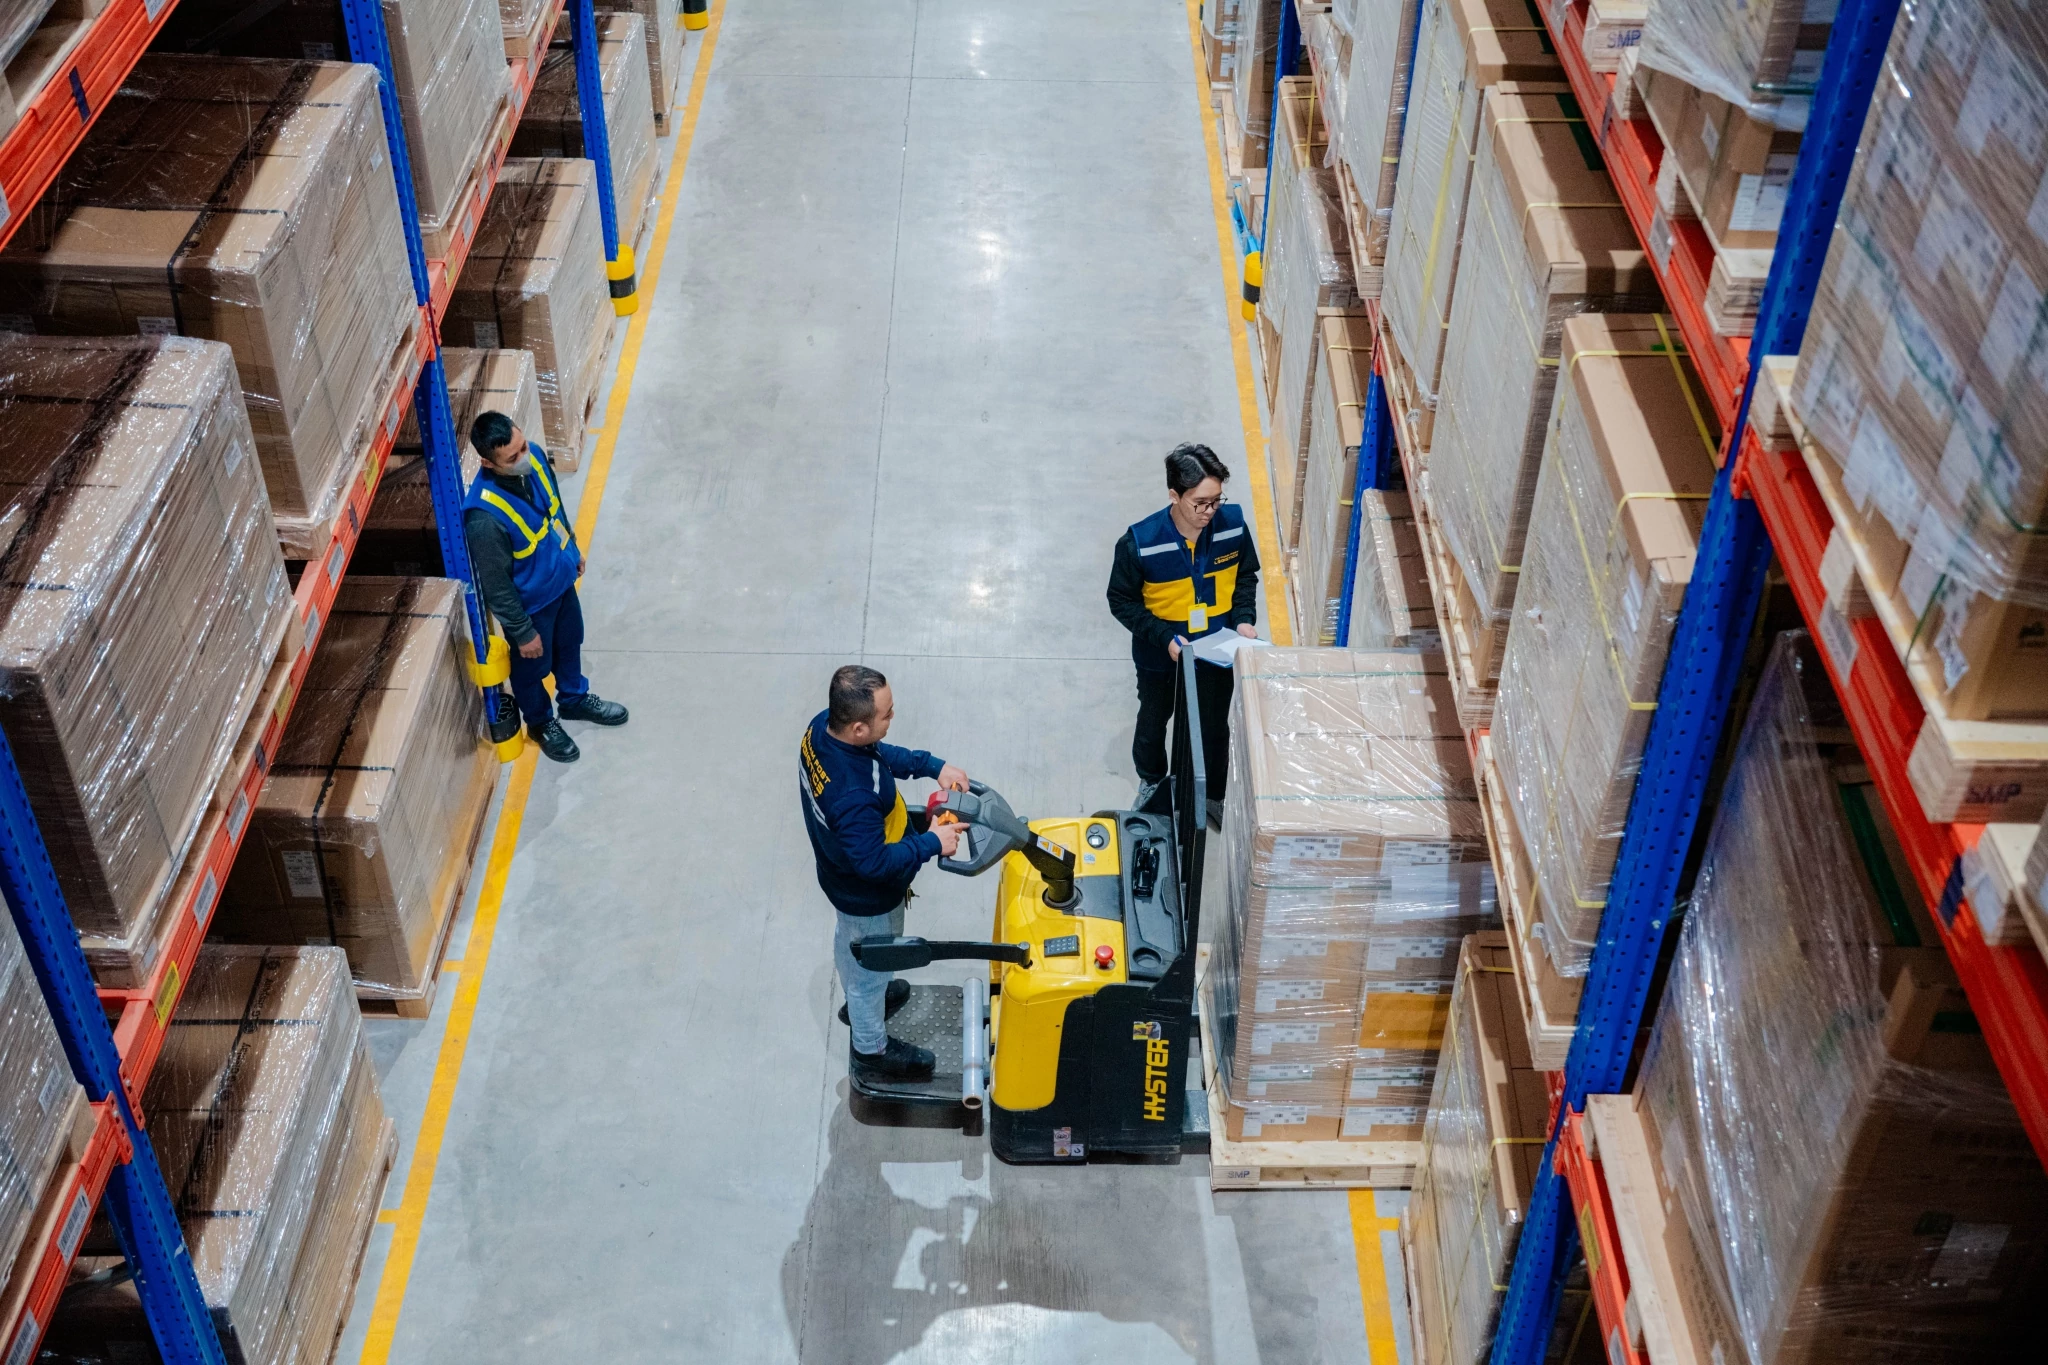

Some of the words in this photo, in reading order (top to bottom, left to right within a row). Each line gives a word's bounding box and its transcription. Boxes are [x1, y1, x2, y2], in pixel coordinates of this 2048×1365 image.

[1607, 29, 1641, 48] SMP
[801, 736, 825, 795] OGISTICS
[814, 759, 832, 784] POST
[1965, 782, 2022, 804] SMP
[1143, 1039, 1169, 1121] HYSTER
[1227, 1170, 1250, 1179] SMP
